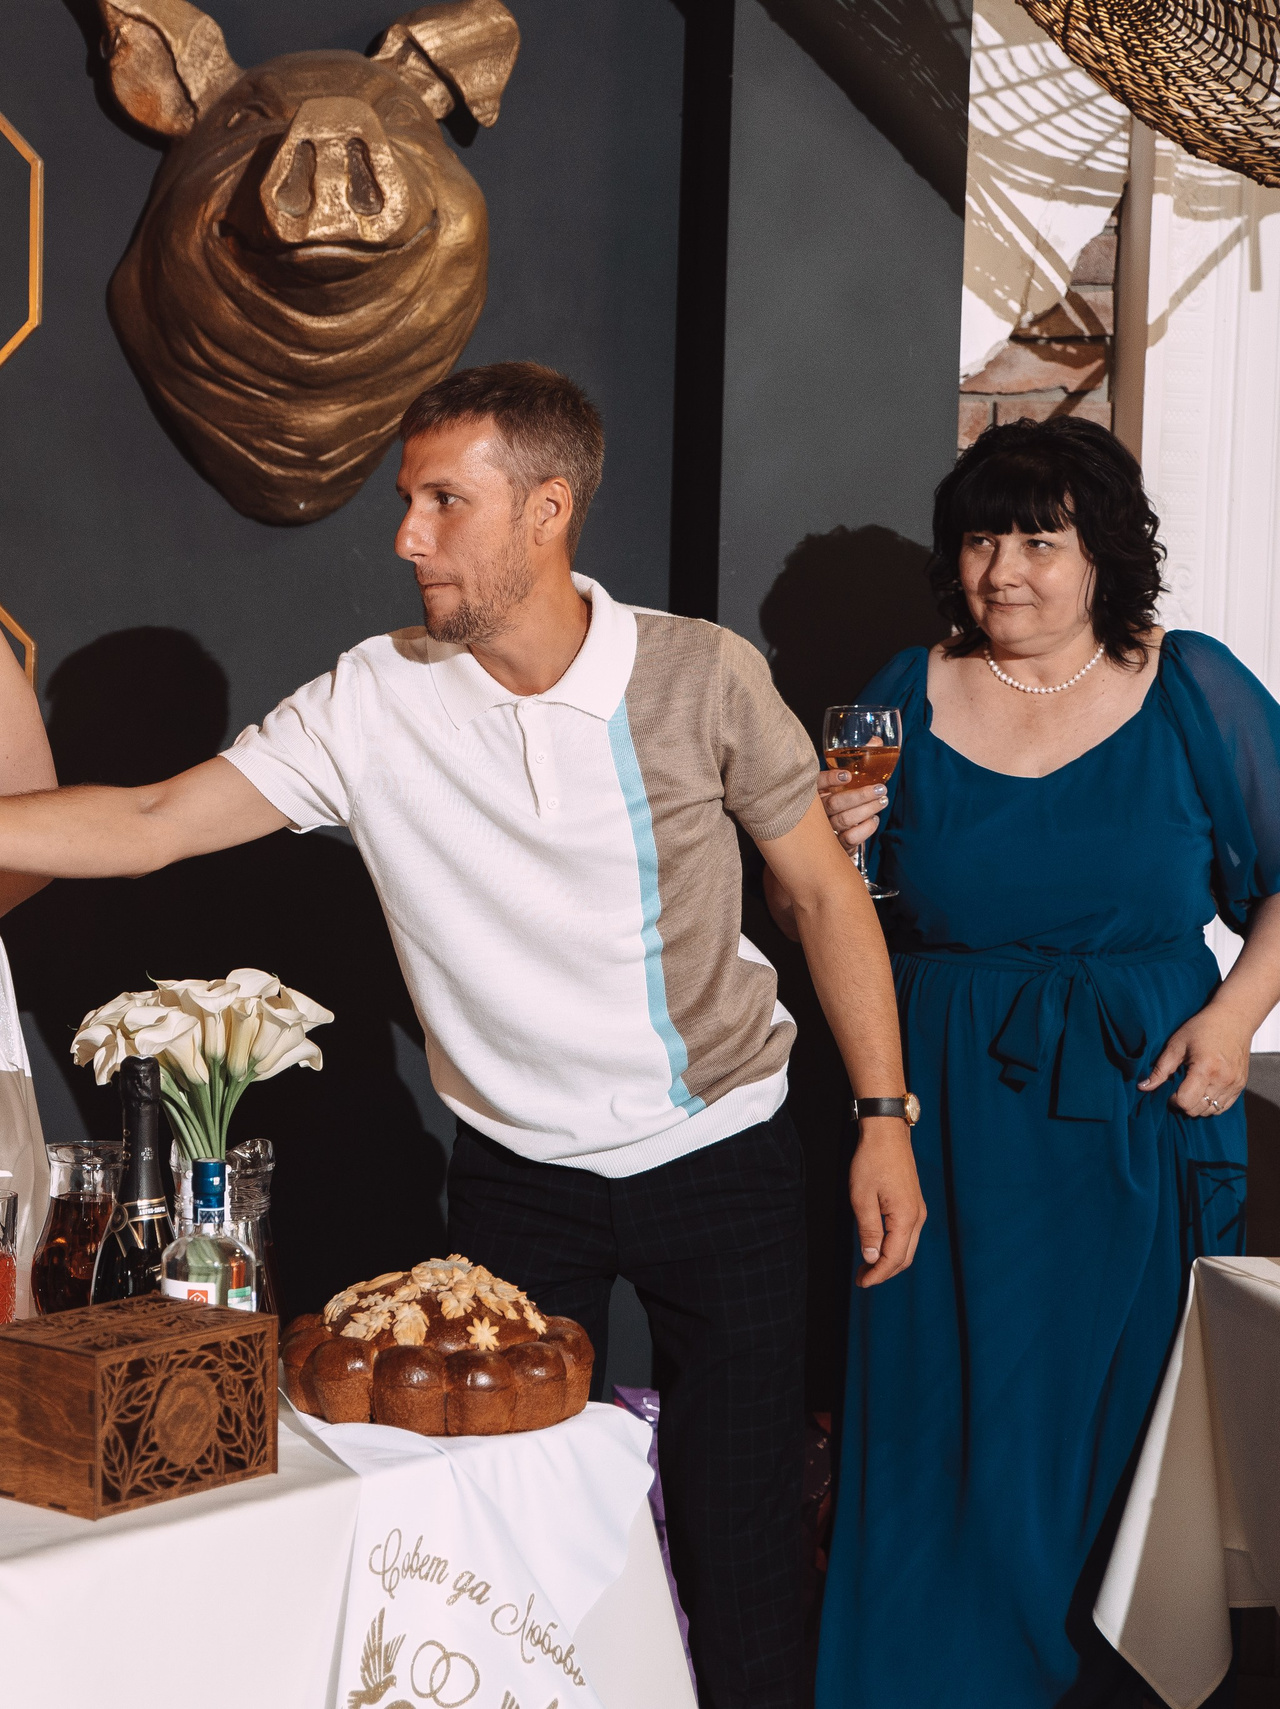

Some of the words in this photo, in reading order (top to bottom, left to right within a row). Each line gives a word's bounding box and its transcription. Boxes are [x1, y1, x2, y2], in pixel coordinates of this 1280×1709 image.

[368, 1527, 450, 1600] Совет
[445, 1566, 492, 1606] да
[489, 1592, 587, 1687] Любовь
